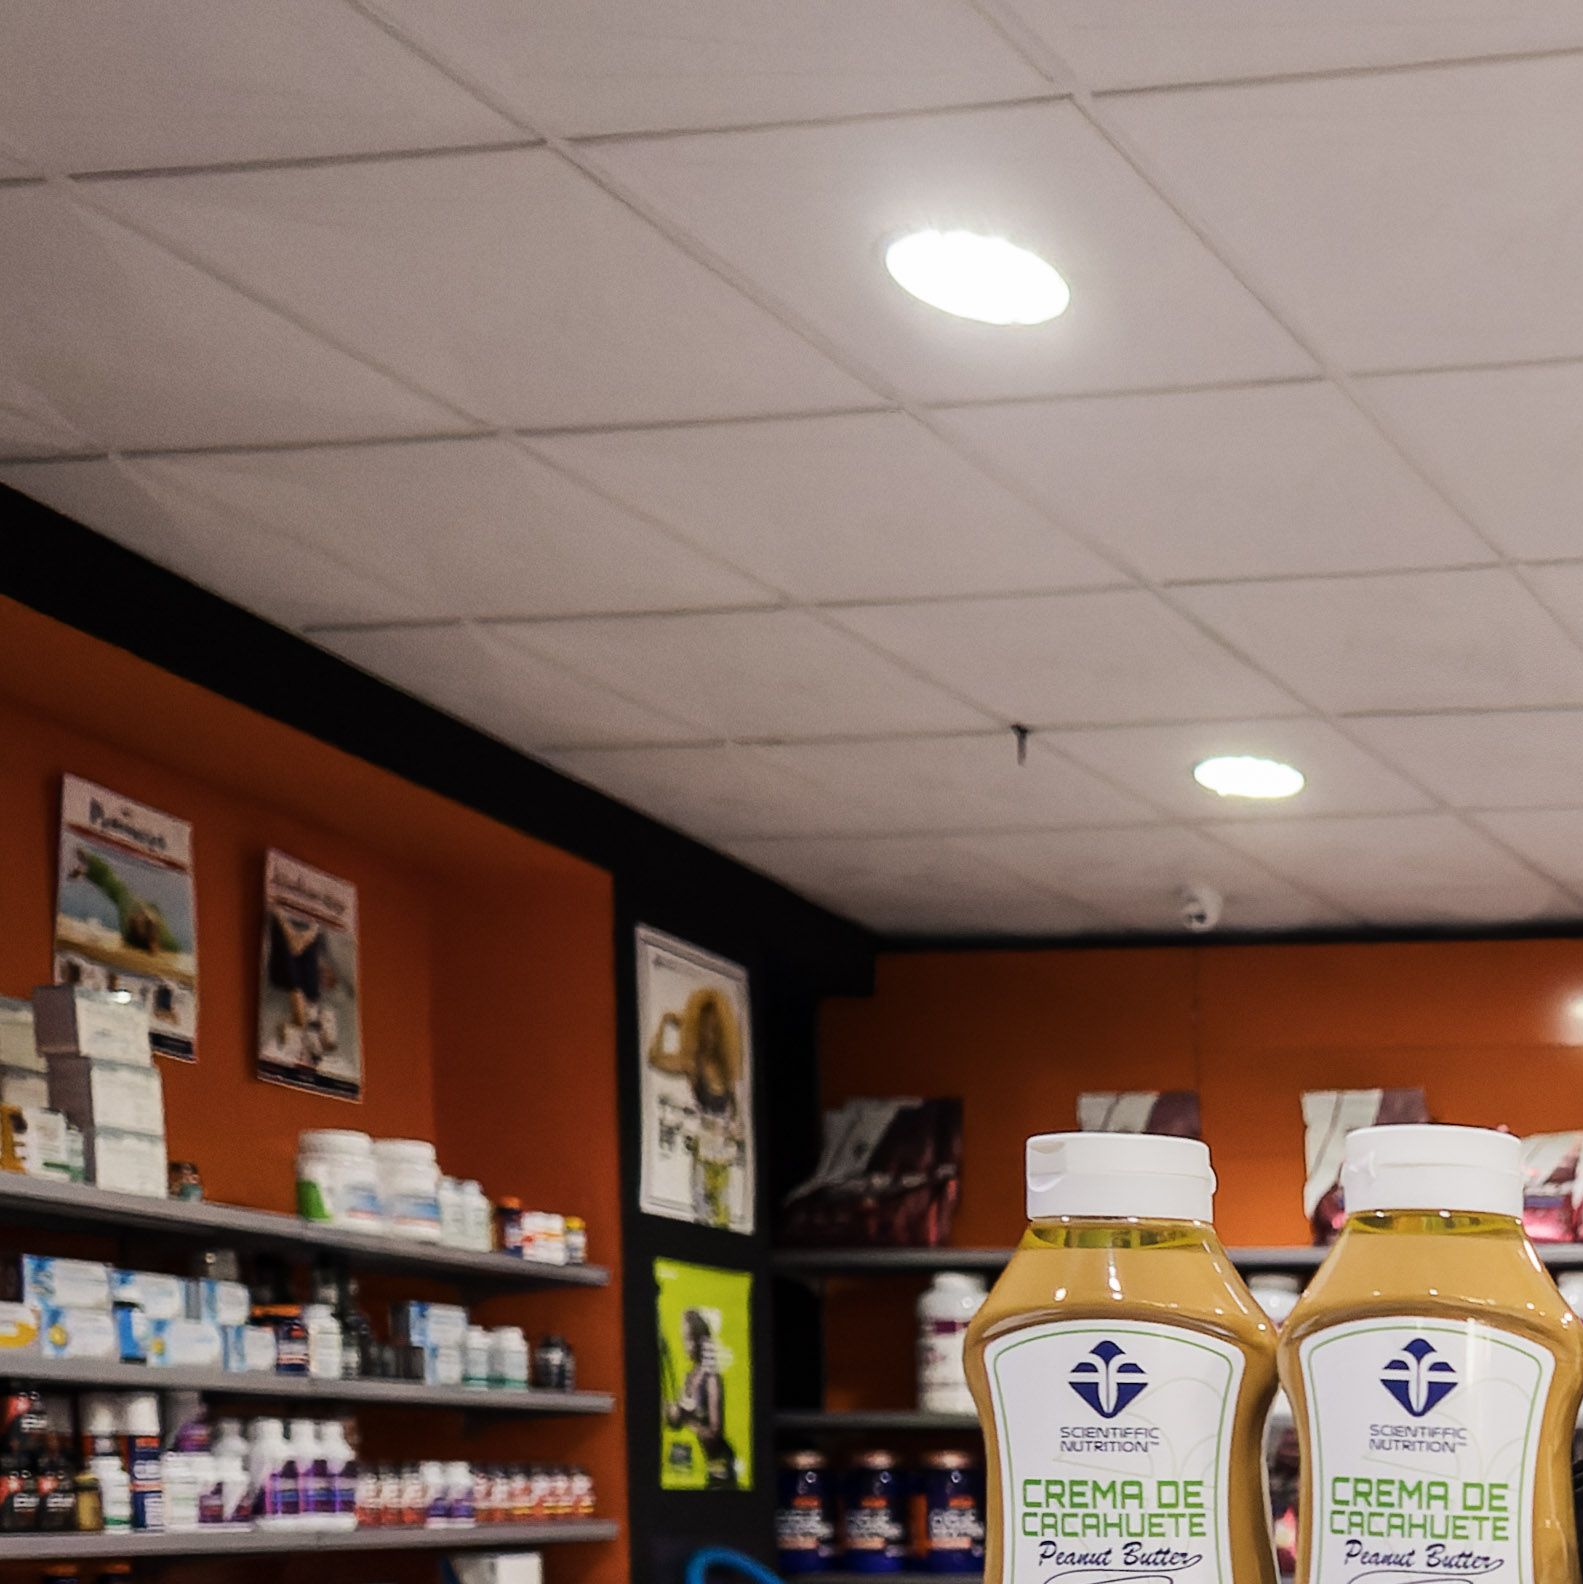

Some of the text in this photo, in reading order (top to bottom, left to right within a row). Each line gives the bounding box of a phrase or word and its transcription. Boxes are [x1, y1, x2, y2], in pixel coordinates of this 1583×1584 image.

[1023, 1479, 1204, 1509] CREMA DE
[1332, 1477, 1509, 1512] CREMA DE
[1021, 1512, 1207, 1538] CACAHUETE
[1330, 1510, 1509, 1541] CACAHUETE
[1038, 1540, 1203, 1567] Peanut Butter
[1344, 1539, 1505, 1570] Peanut Butter
